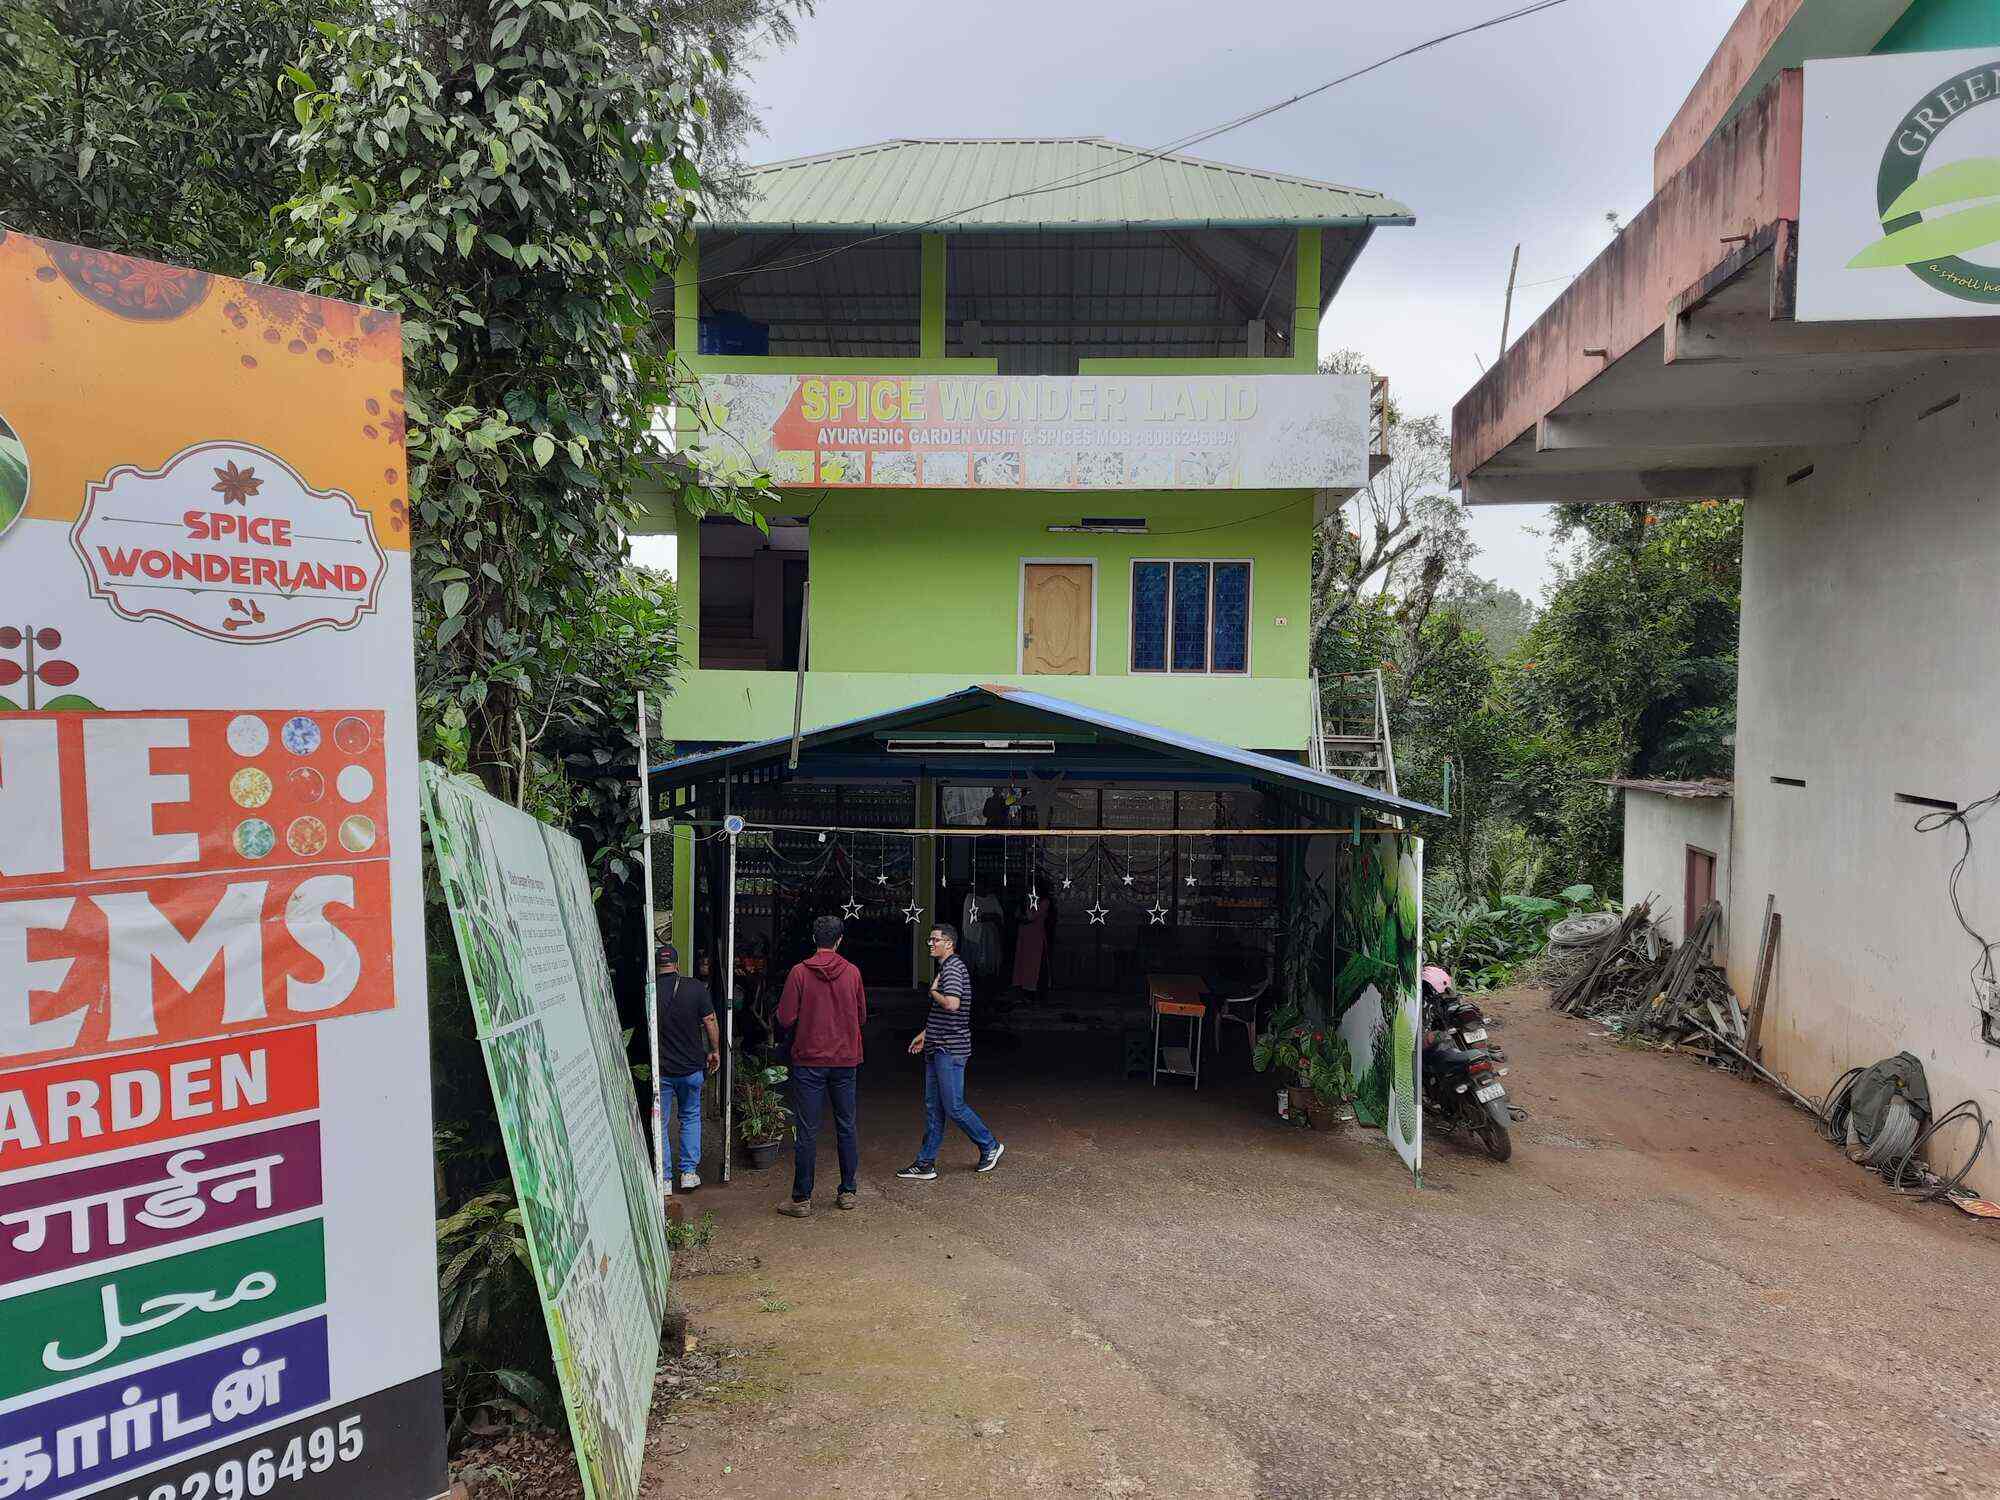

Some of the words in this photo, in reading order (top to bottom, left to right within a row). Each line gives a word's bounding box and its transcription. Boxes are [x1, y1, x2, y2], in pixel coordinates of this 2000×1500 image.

[1939, 270, 1980, 289] stroll
[801, 380, 927, 422] SPICE
[938, 381, 1129, 422] WONDER
[1145, 382, 1259, 422] LAND
[817, 427, 904, 445] AYURVEDIC
[908, 428, 970, 445] GARDEN
[976, 429, 1016, 446] VISIT
[183, 510, 292, 547] SPICE
[97, 545, 368, 594] WONDERLAND
[42, 1271, 277, 1372] محل
